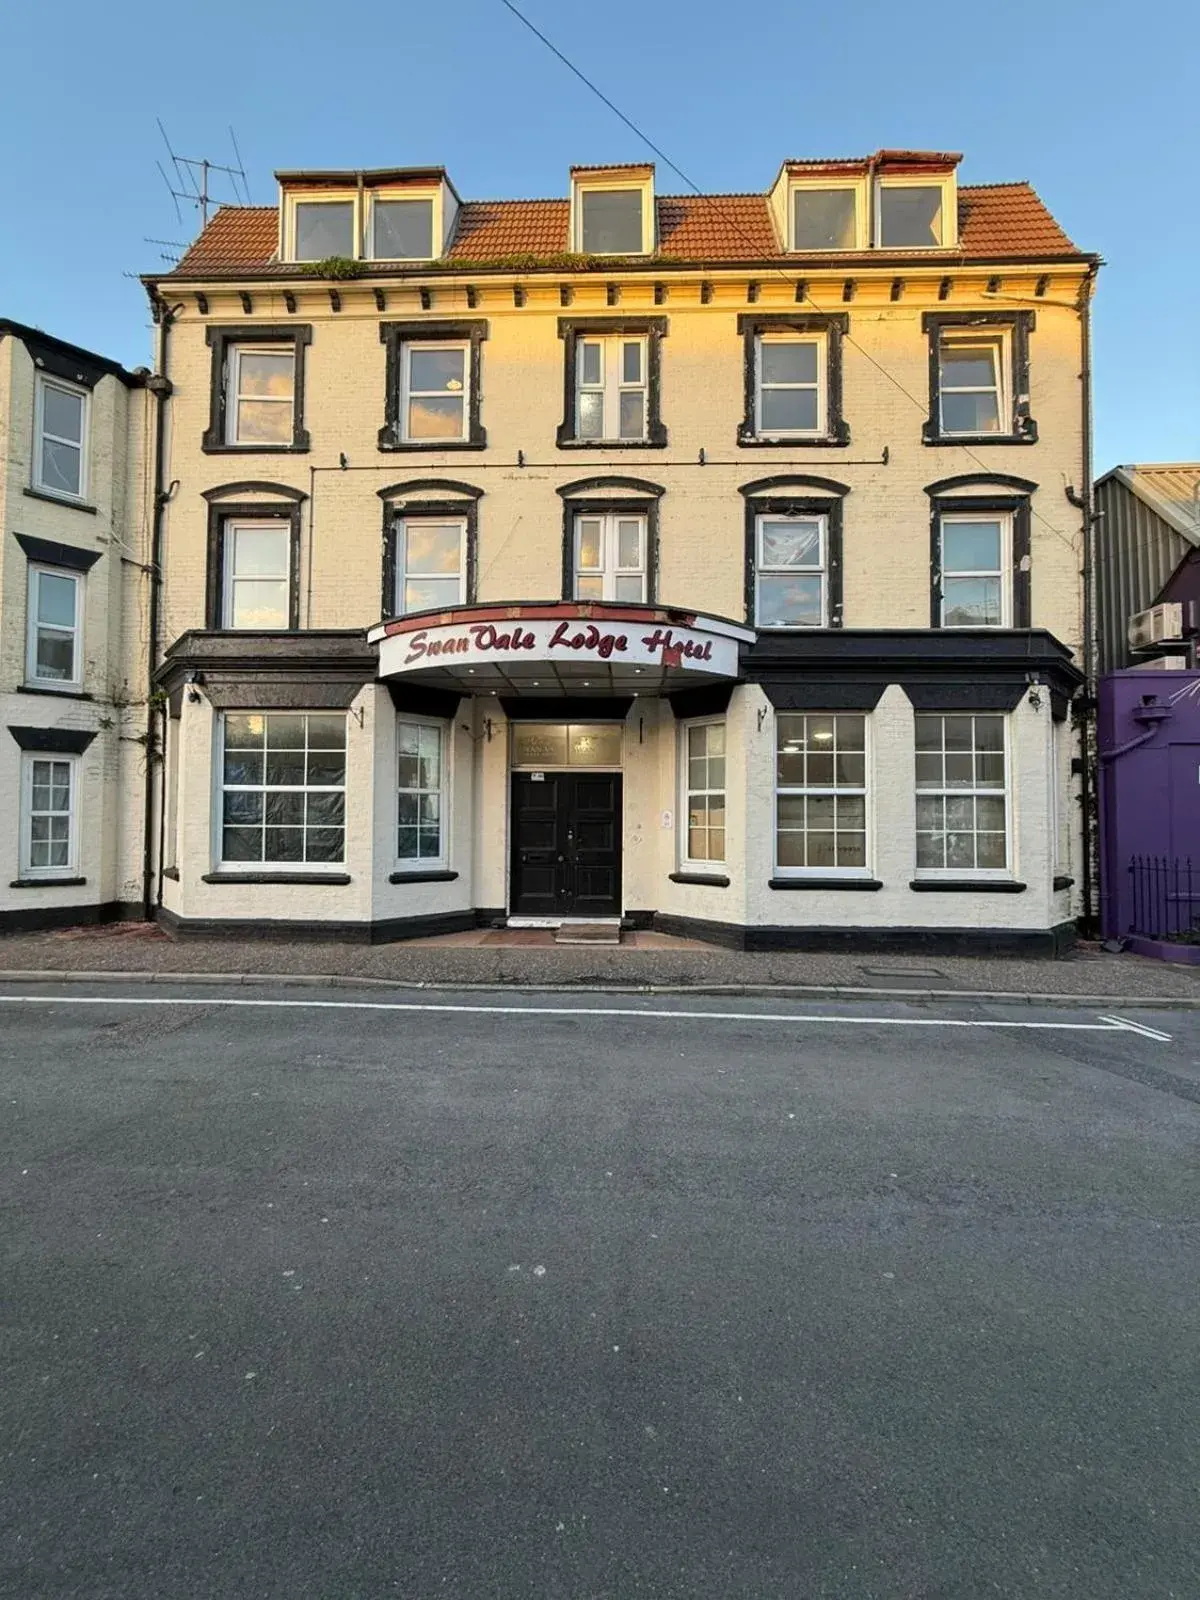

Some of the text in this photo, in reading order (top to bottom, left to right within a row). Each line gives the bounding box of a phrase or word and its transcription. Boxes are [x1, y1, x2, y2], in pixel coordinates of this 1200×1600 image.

[404, 621, 712, 664] Swan Vale Lodge Hotel
